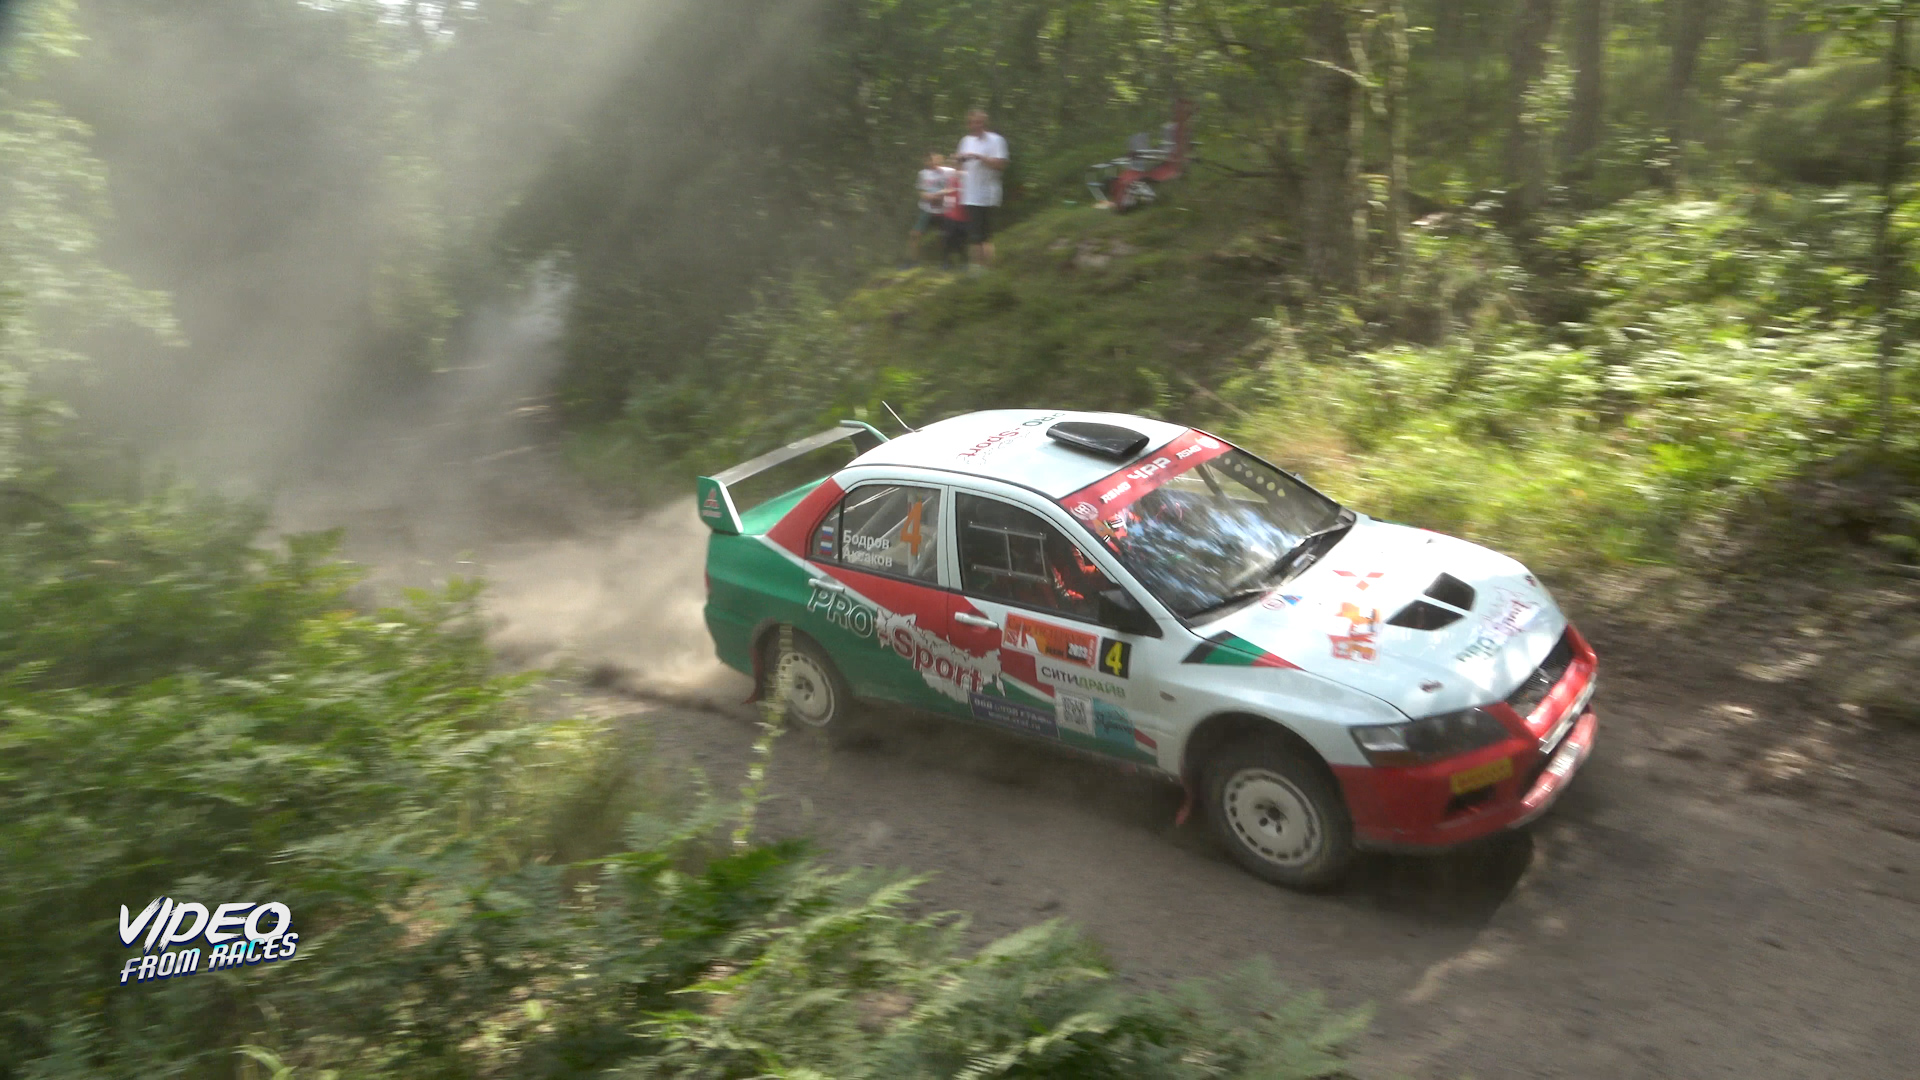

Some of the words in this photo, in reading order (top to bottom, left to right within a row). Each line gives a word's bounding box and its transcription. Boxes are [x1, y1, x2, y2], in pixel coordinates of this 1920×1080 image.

[842, 529, 890, 551] Бодров
[901, 499, 923, 556] 4
[1105, 641, 1123, 676] 4
